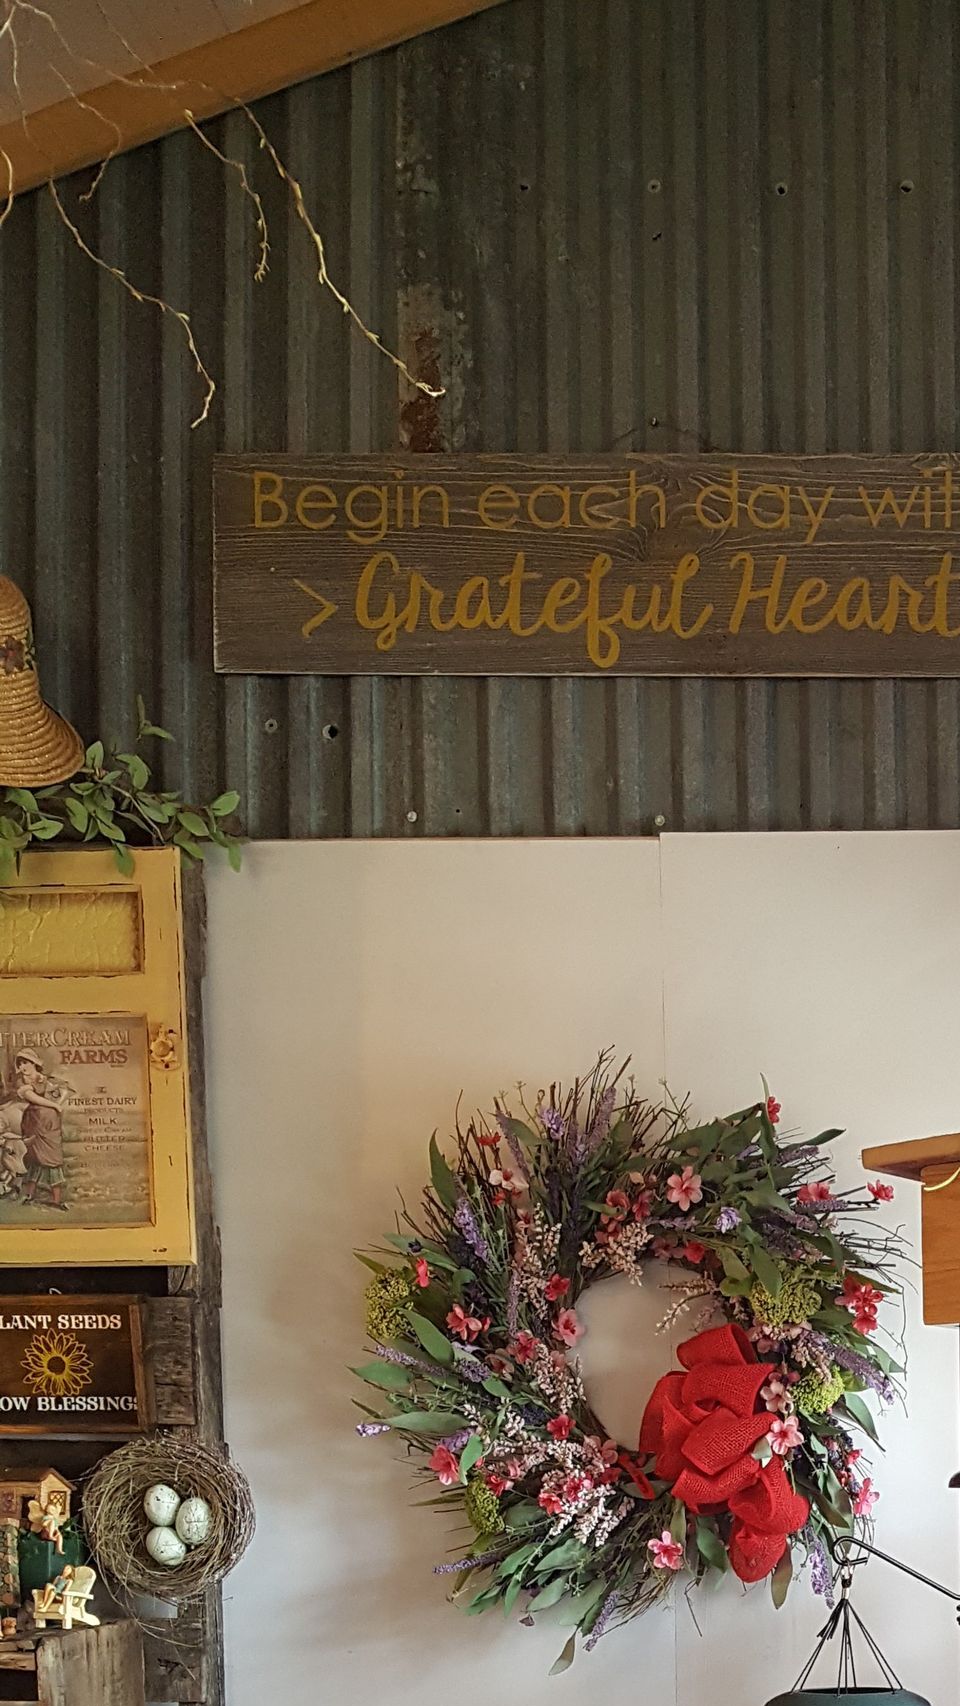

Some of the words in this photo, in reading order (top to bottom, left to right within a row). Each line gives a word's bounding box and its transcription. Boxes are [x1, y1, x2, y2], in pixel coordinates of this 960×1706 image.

[253, 470, 450, 545] Begin
[477, 469, 668, 531] each
[695, 468, 835, 545] day
[355, 551, 714, 669] Grateful
[59, 1048, 129, 1065] FARMS
[67, 1098, 105, 1106] FINEST
[106, 1097, 137, 1106] DAIRY
[88, 1117, 118, 1126] MILK
[57, 1314, 122, 1330] SEEDS
[0, 1396, 31, 1412] OW
